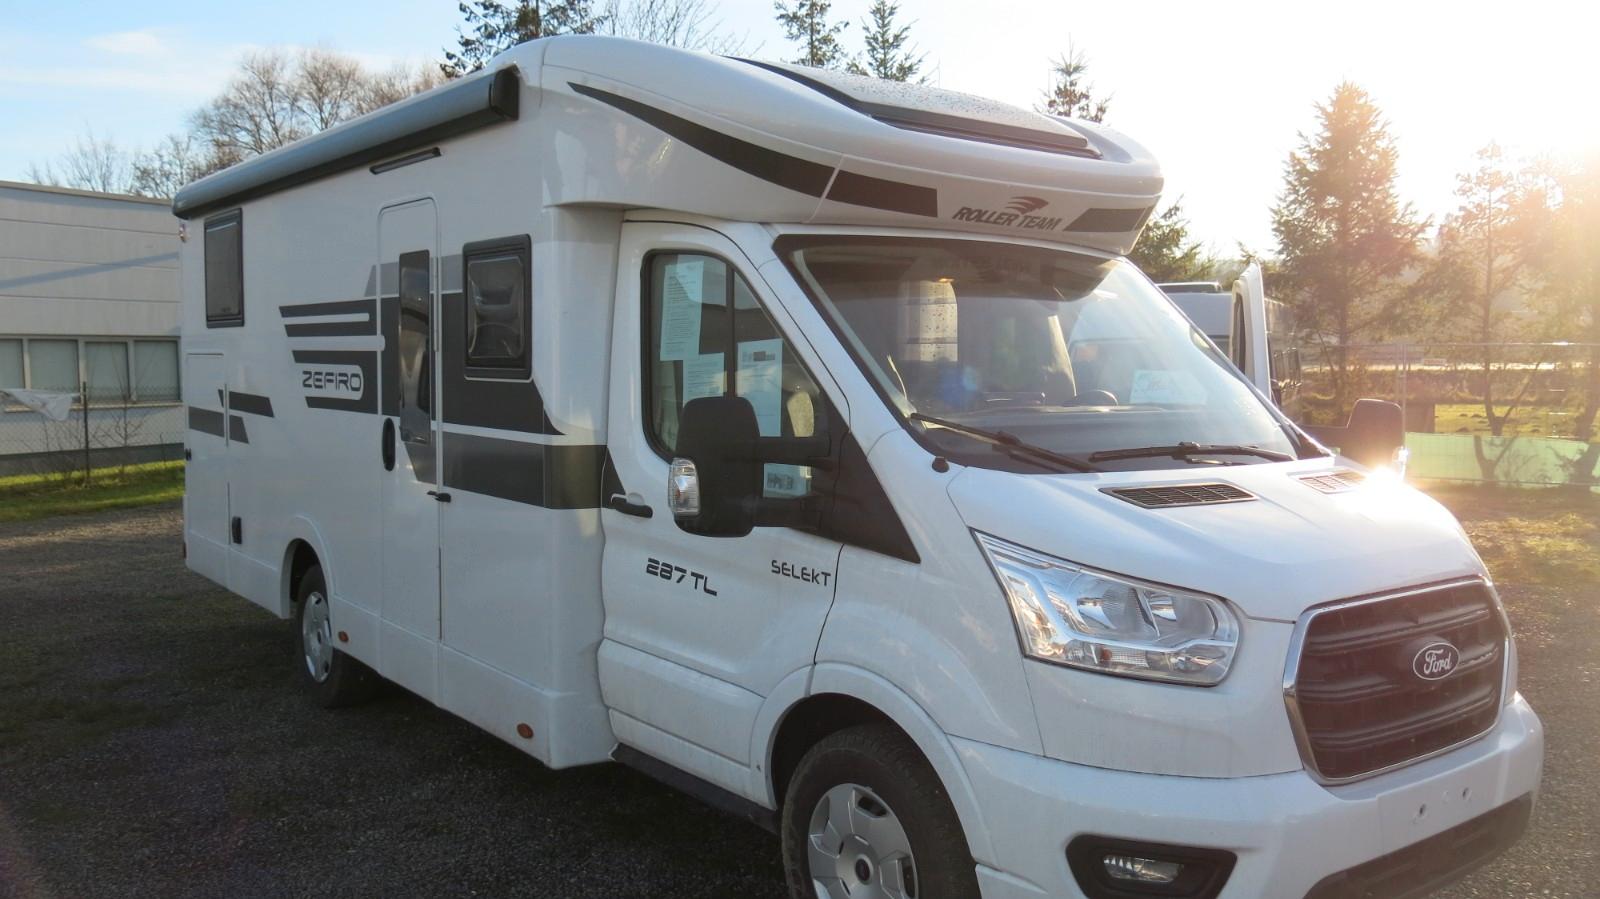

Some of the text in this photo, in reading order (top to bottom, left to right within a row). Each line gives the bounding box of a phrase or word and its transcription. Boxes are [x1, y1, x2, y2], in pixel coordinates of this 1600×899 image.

[952, 206, 1063, 231] ROLLER TEAM
[302, 370, 362, 392] ZEFIRO
[771, 559, 831, 587] SELEKT
[1423, 648, 1453, 675] Ford
